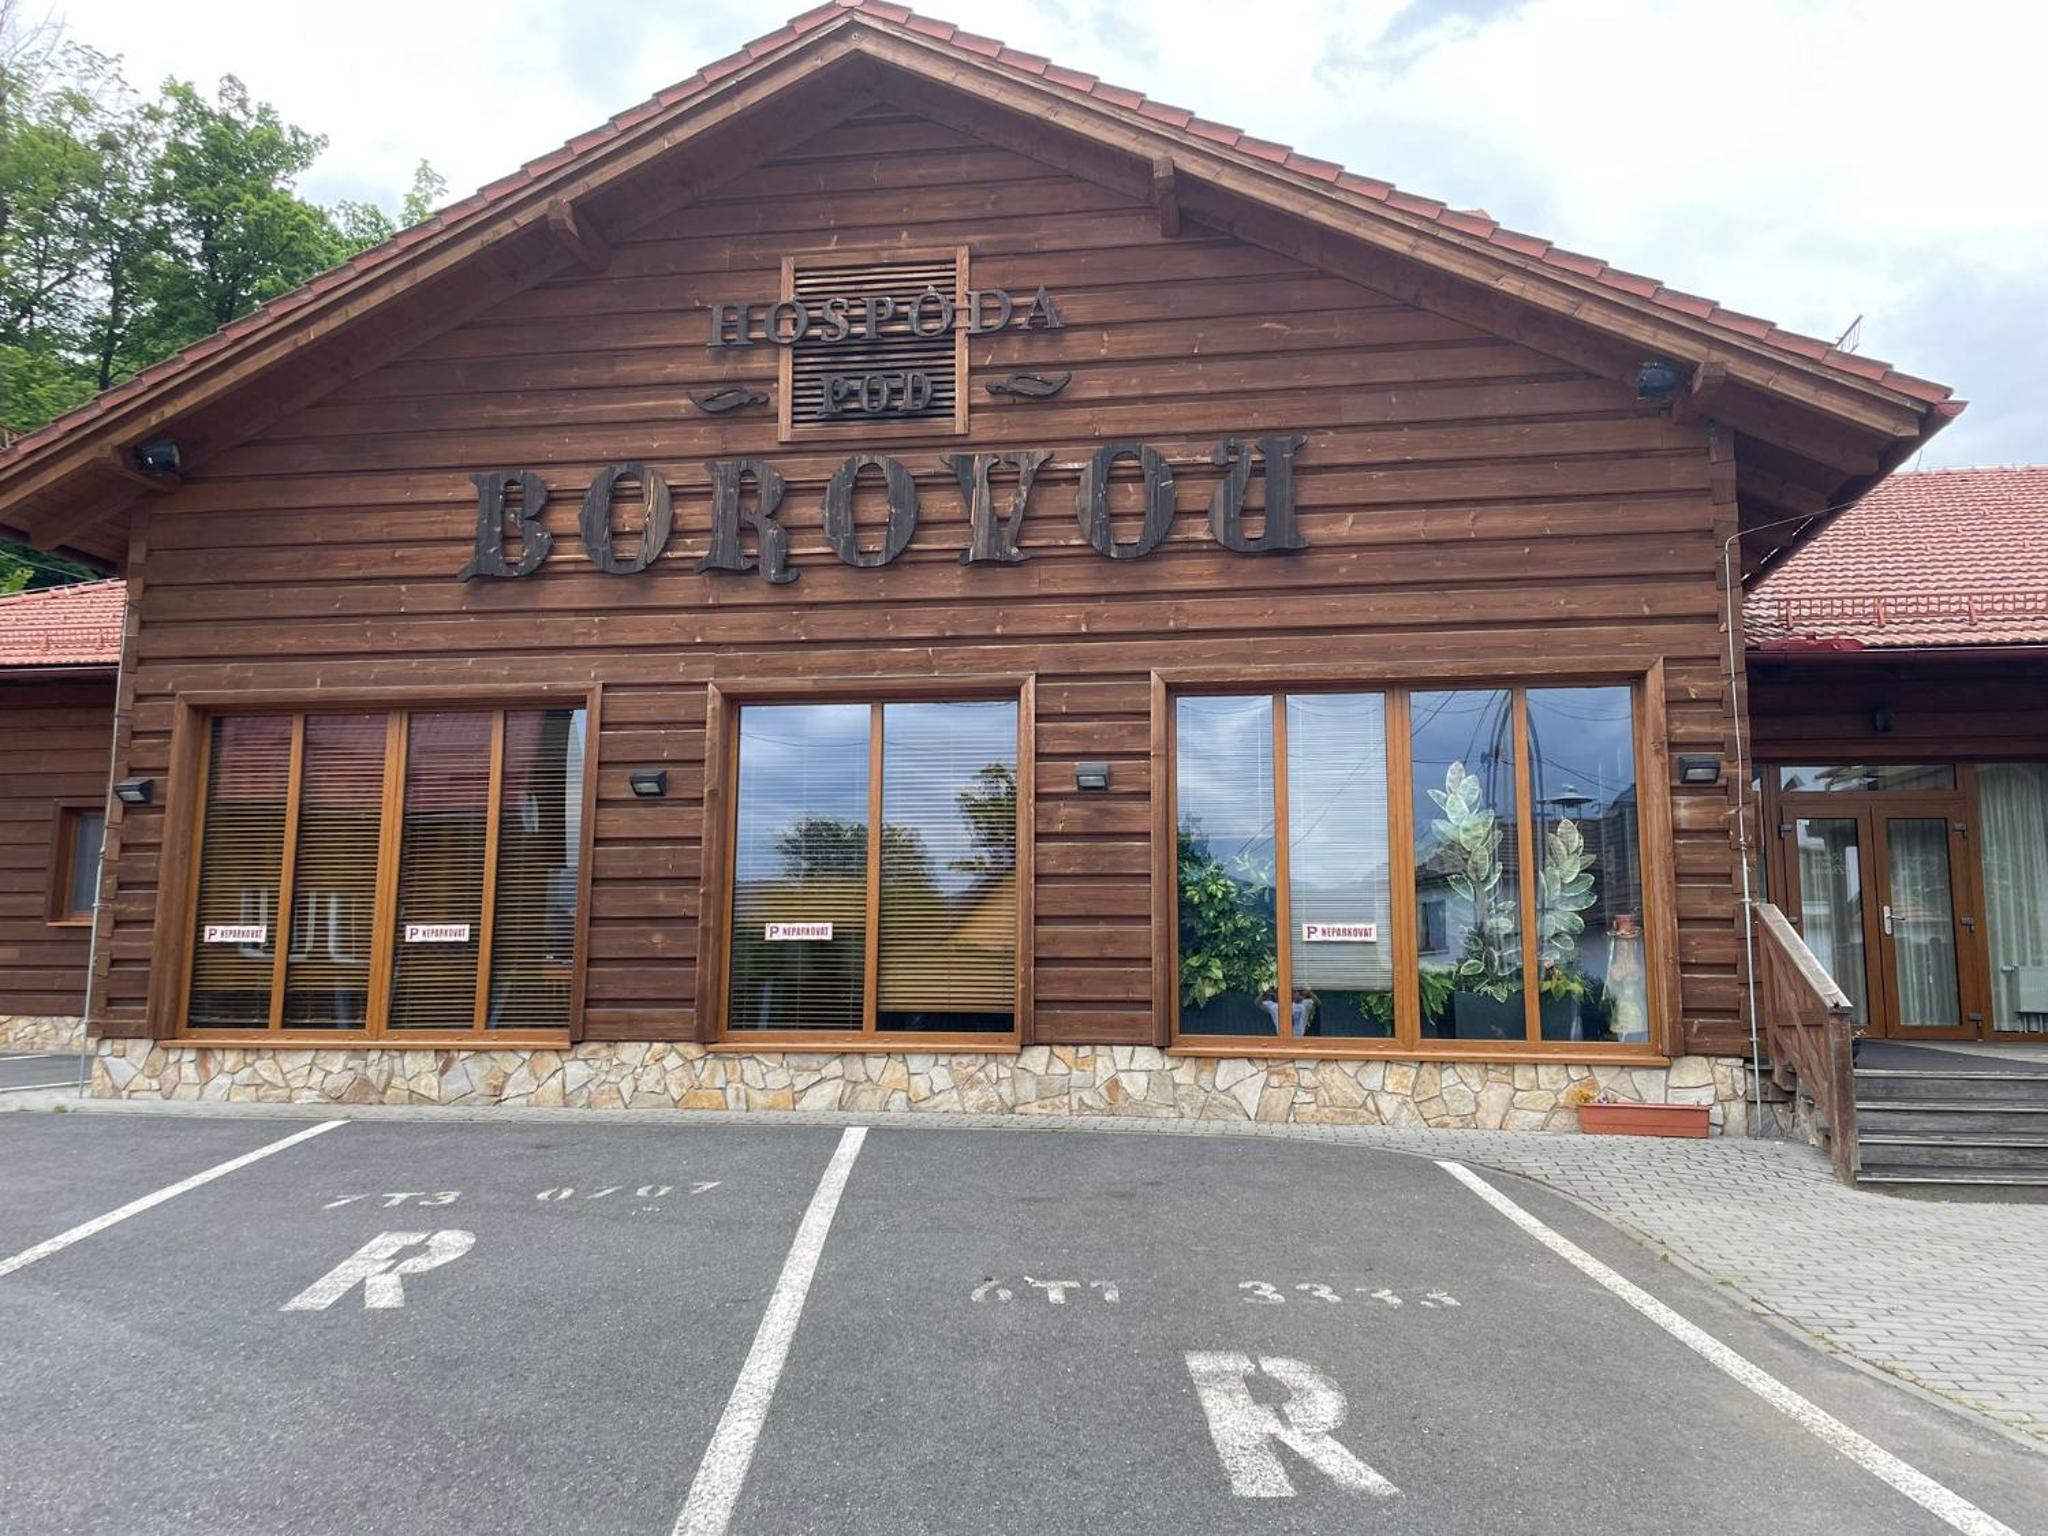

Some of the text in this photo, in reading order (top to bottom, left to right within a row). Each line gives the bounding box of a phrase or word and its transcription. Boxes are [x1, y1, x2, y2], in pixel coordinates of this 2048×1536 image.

[706, 285, 1065, 348] HOSPODA
[817, 369, 933, 415] POD
[457, 434, 1310, 585] BOROVOU
[208, 927, 263, 940] P NEPARKOVAT
[409, 927, 466, 940] P NEPARKOVAT
[769, 925, 829, 939] P NEPARKOVAT
[1306, 926, 1372, 939] P NEPARKOVAT
[278, 1229, 477, 1312] R
[1184, 1349, 1405, 1499] R
